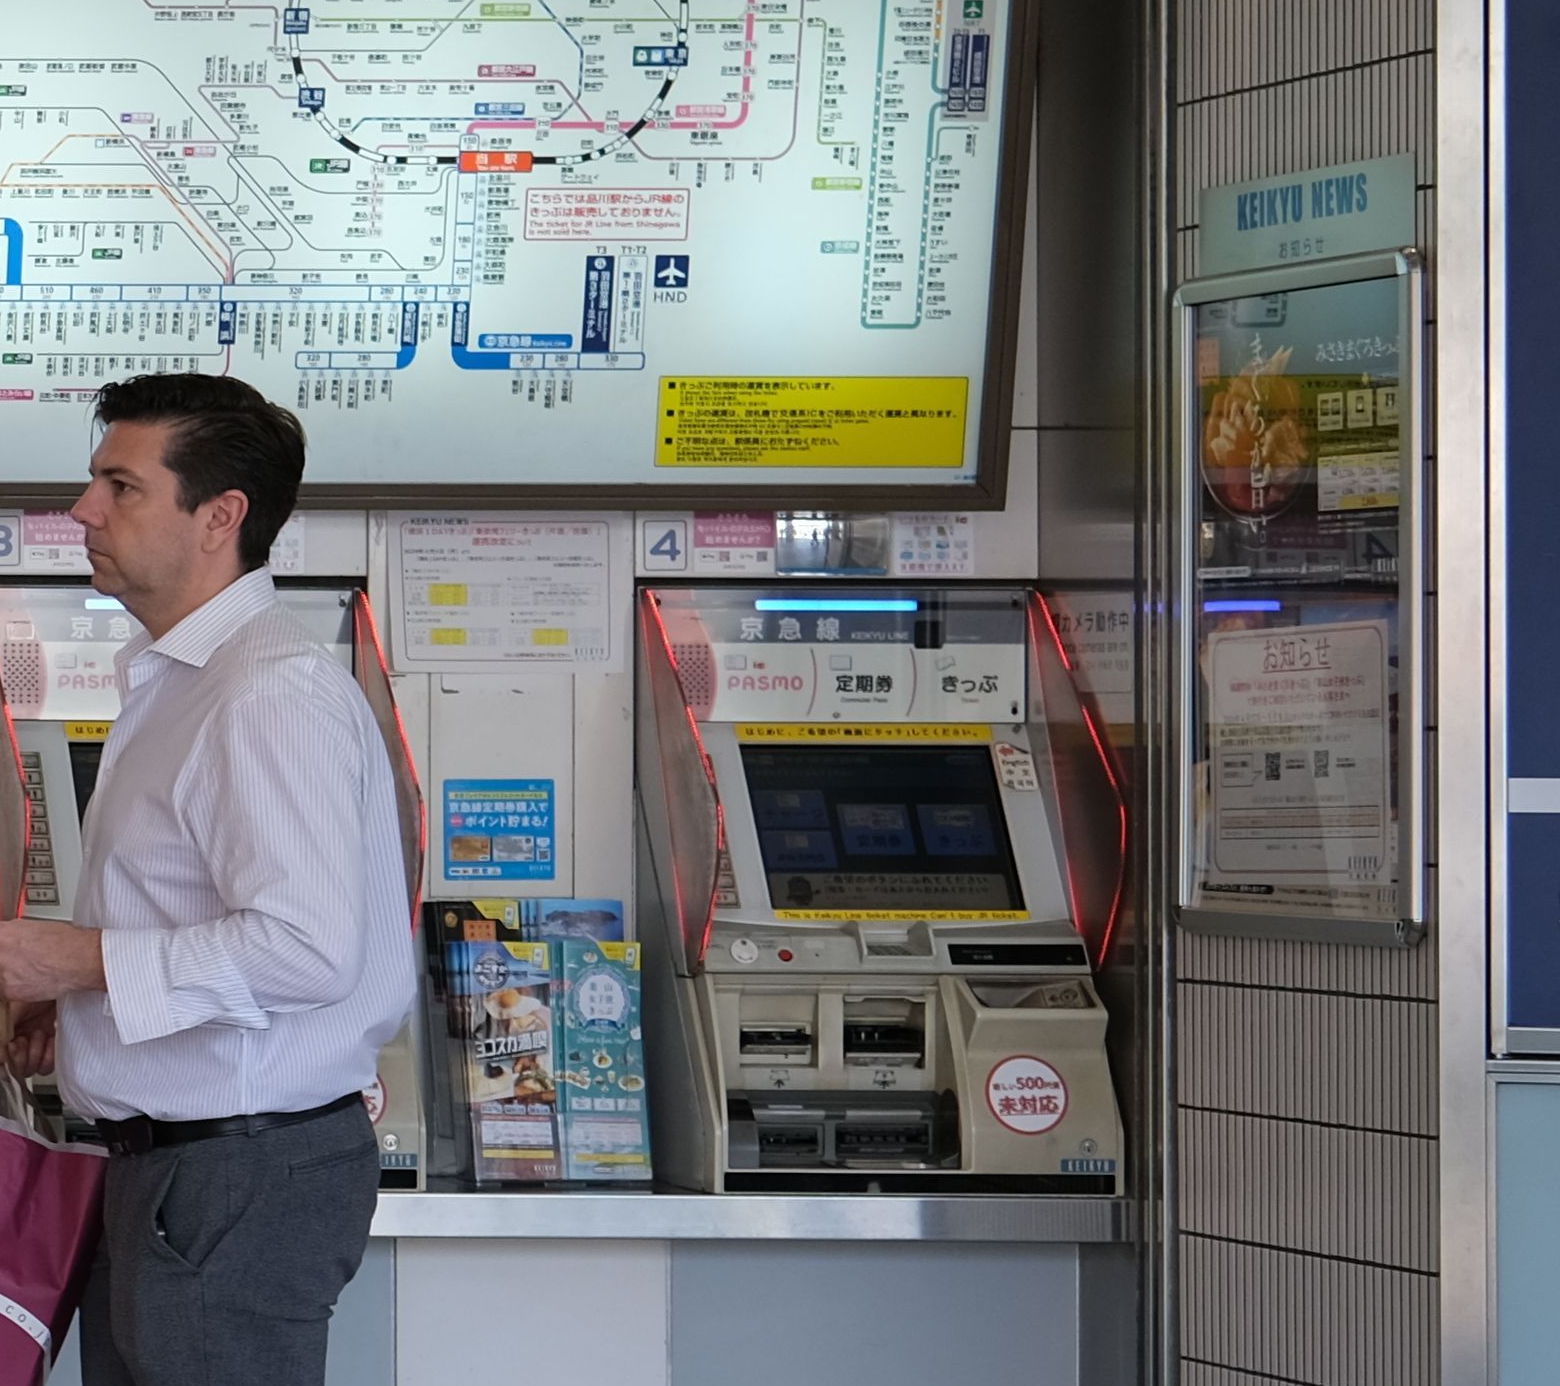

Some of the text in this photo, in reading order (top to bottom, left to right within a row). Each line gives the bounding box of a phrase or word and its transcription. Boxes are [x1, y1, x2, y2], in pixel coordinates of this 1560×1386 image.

[1237, 174, 1368, 231] KEIKYU NEWS
[1278, 238, 1324, 259] お知らせ
[654, 292, 687, 303] HND
[650, 531, 681, 561] 4
[740, 619, 840, 640] 京急線
[1263, 638, 1331, 670] お知らせ
[728, 676, 997, 693] PASMO 定期券 きっぷ
[998, 1095, 1058, 1114] 未対応
